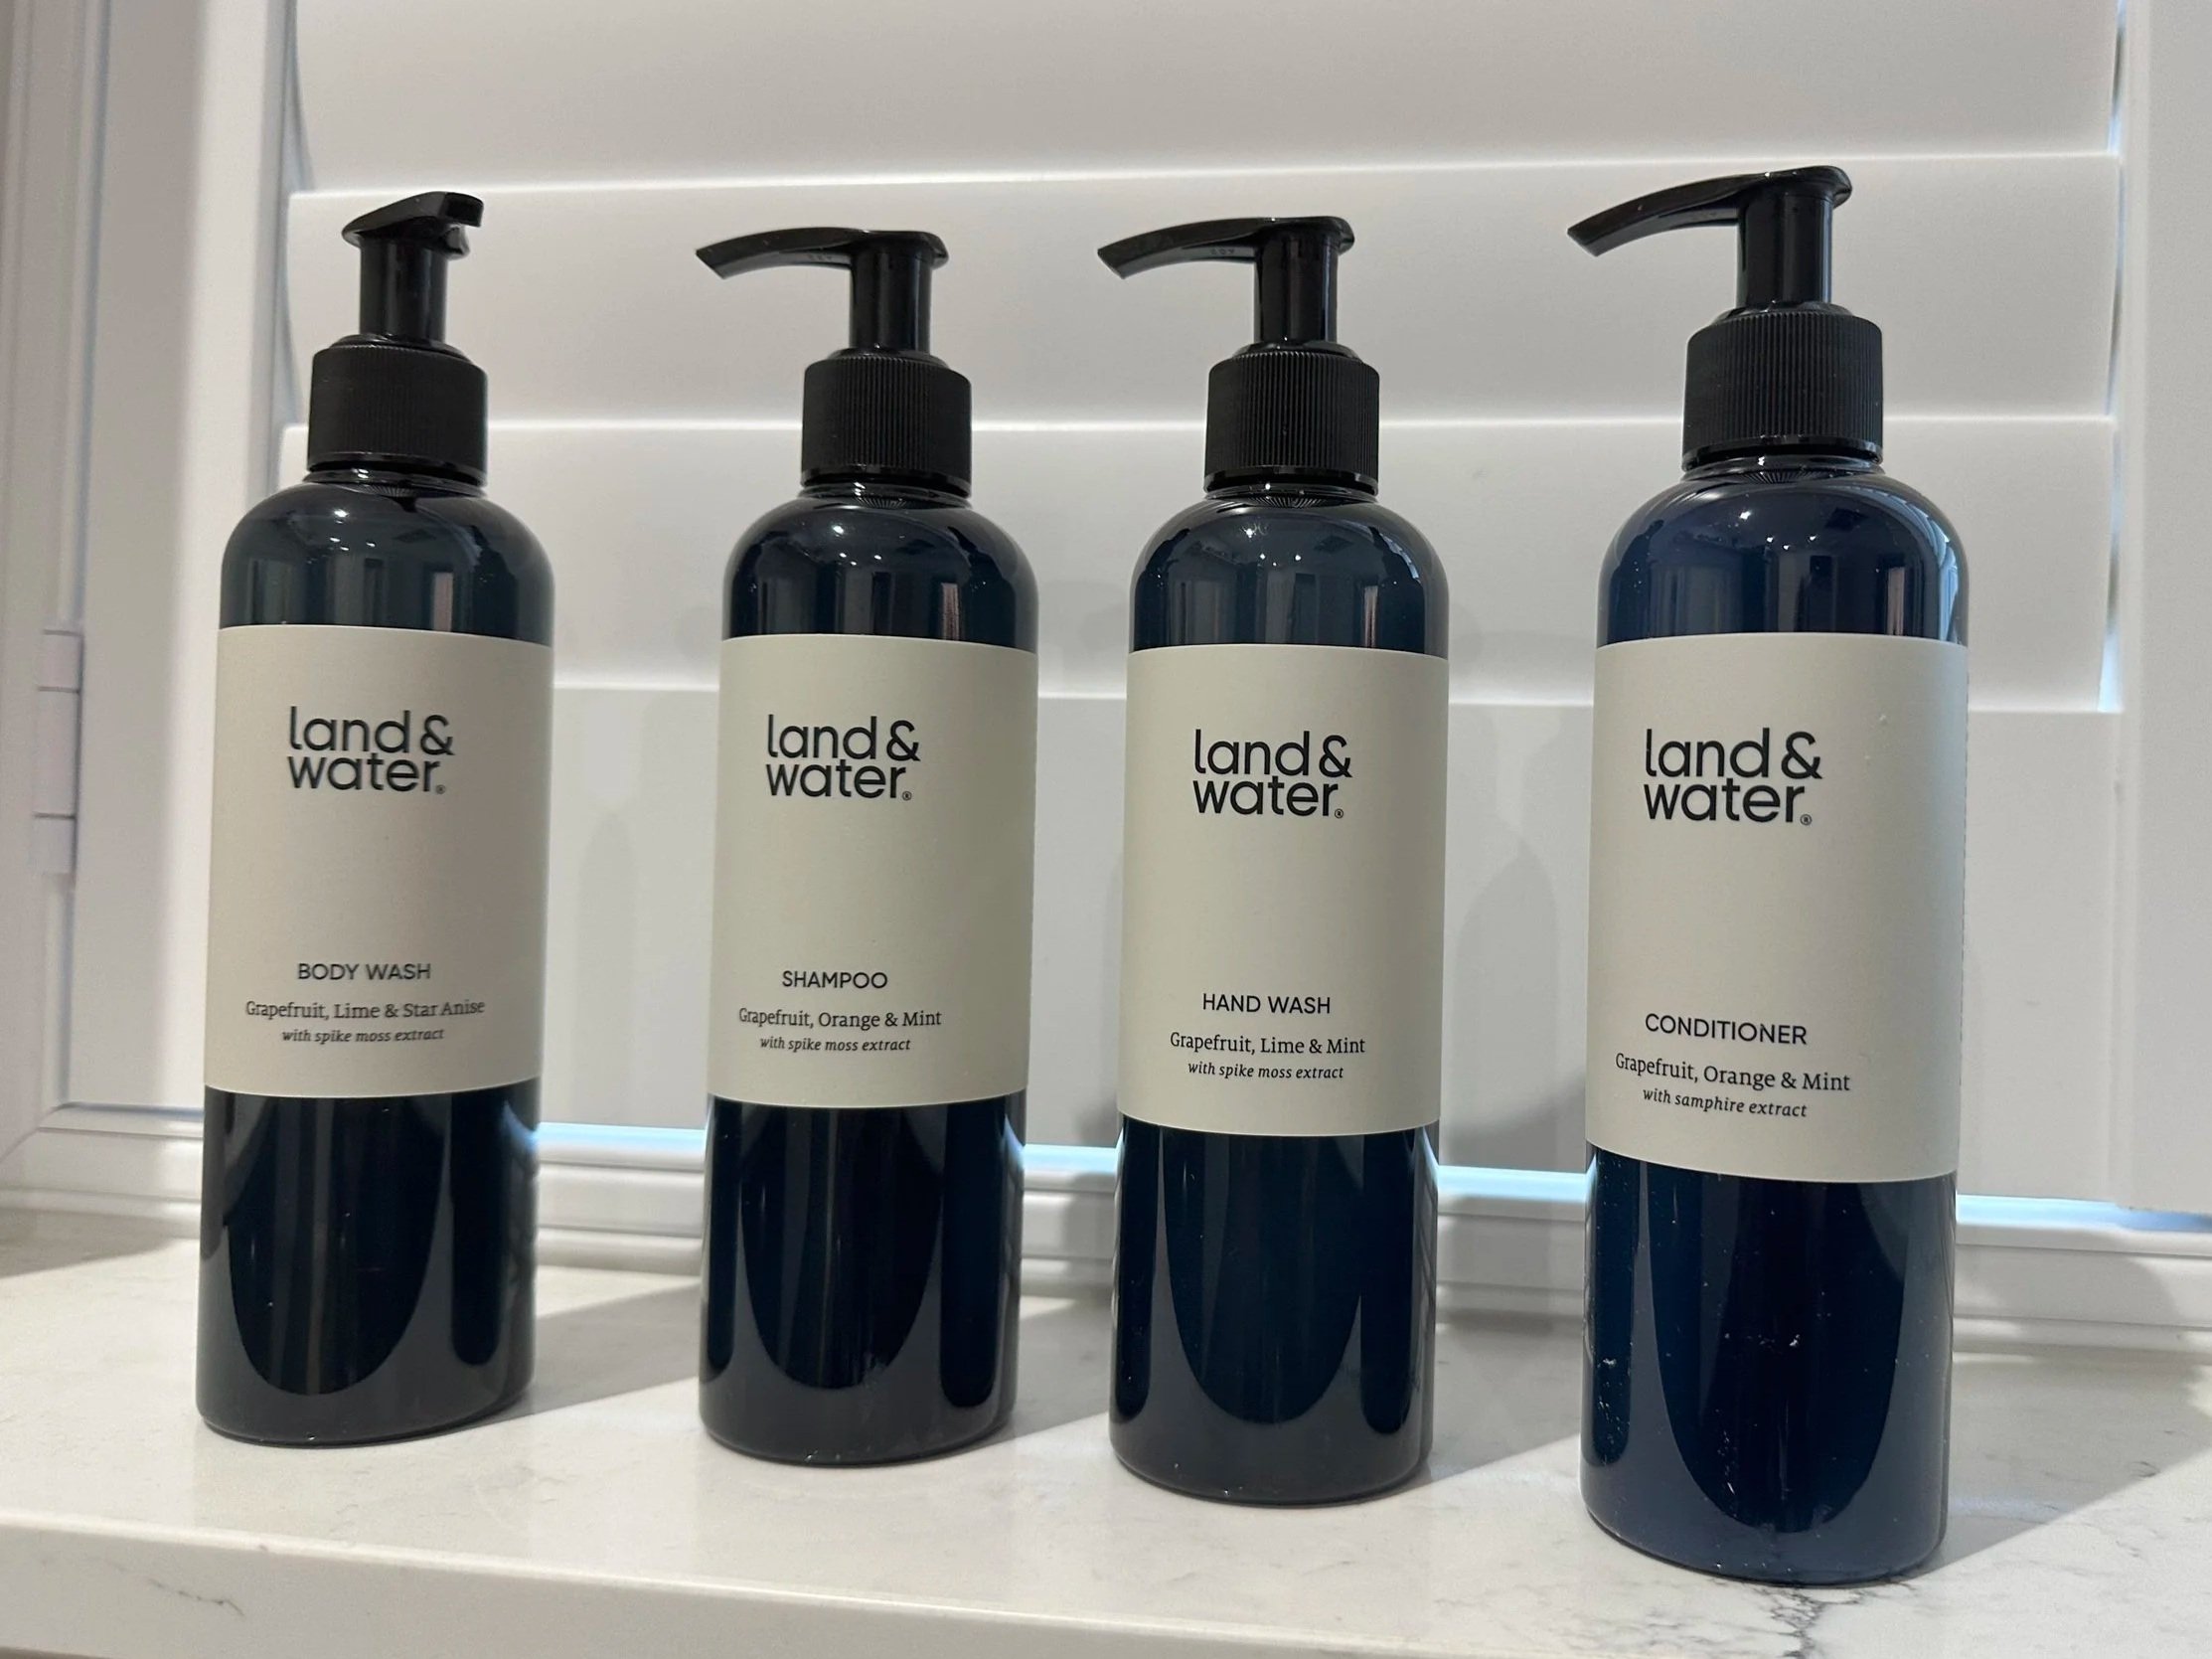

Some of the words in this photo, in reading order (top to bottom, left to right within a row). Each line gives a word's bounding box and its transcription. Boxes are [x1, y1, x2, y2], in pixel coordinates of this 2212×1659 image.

[296, 962, 361, 981] BODY
[364, 962, 432, 981] WASH
[781, 969, 889, 990] SHAMPOO
[244, 1000, 331, 1022] Grapefruit,
[331, 1002, 382, 1020] Lime
[382, 1003, 401, 1020] &
[401, 1002, 439, 1019] Star
[439, 998, 486, 1018] Anise
[1202, 992, 1262, 1014] HAND
[1266, 995, 1332, 1015] WASH
[738, 1007, 815, 1030] Grapefruit,
[817, 1011, 881, 1033] Orange
[883, 1011, 899, 1028] &
[900, 1009, 943, 1028] Mint
[1645, 1012, 1809, 1047] CONDITIONER
[280, 1028, 313, 1043] with
[313, 1029, 354, 1046] spike
[354, 1031, 393, 1043] moss
[392, 1028, 445, 1043] extract
[759, 1035, 786, 1051] with
[787, 1037, 823, 1054] spike
[824, 1041, 860, 1053] moss
[861, 1039, 912, 1053] extract
[1170, 1031, 1256, 1057] Grapefruit,
[1259, 1036, 1306, 1056] Lime
[1308, 1038, 1324, 1055] &
[1325, 1036, 1366, 1055] Mint
[1187, 1060, 1216, 1077] with
[1217, 1063, 1255, 1080] spike
[1257, 1067, 1293, 1079] moss
[1295, 1067, 1344, 1079] extract
[1615, 1052, 1699, 1084] Grapefruit,
[1702, 1065, 1777, 1092] Orange
[1780, 1071, 1798, 1090] &
[1801, 1071, 1851, 1092] Mint
[1642, 1087, 1672, 1105] with
[1673, 1092, 1746, 1114] samphire
[1747, 1099, 1809, 1119] extract
